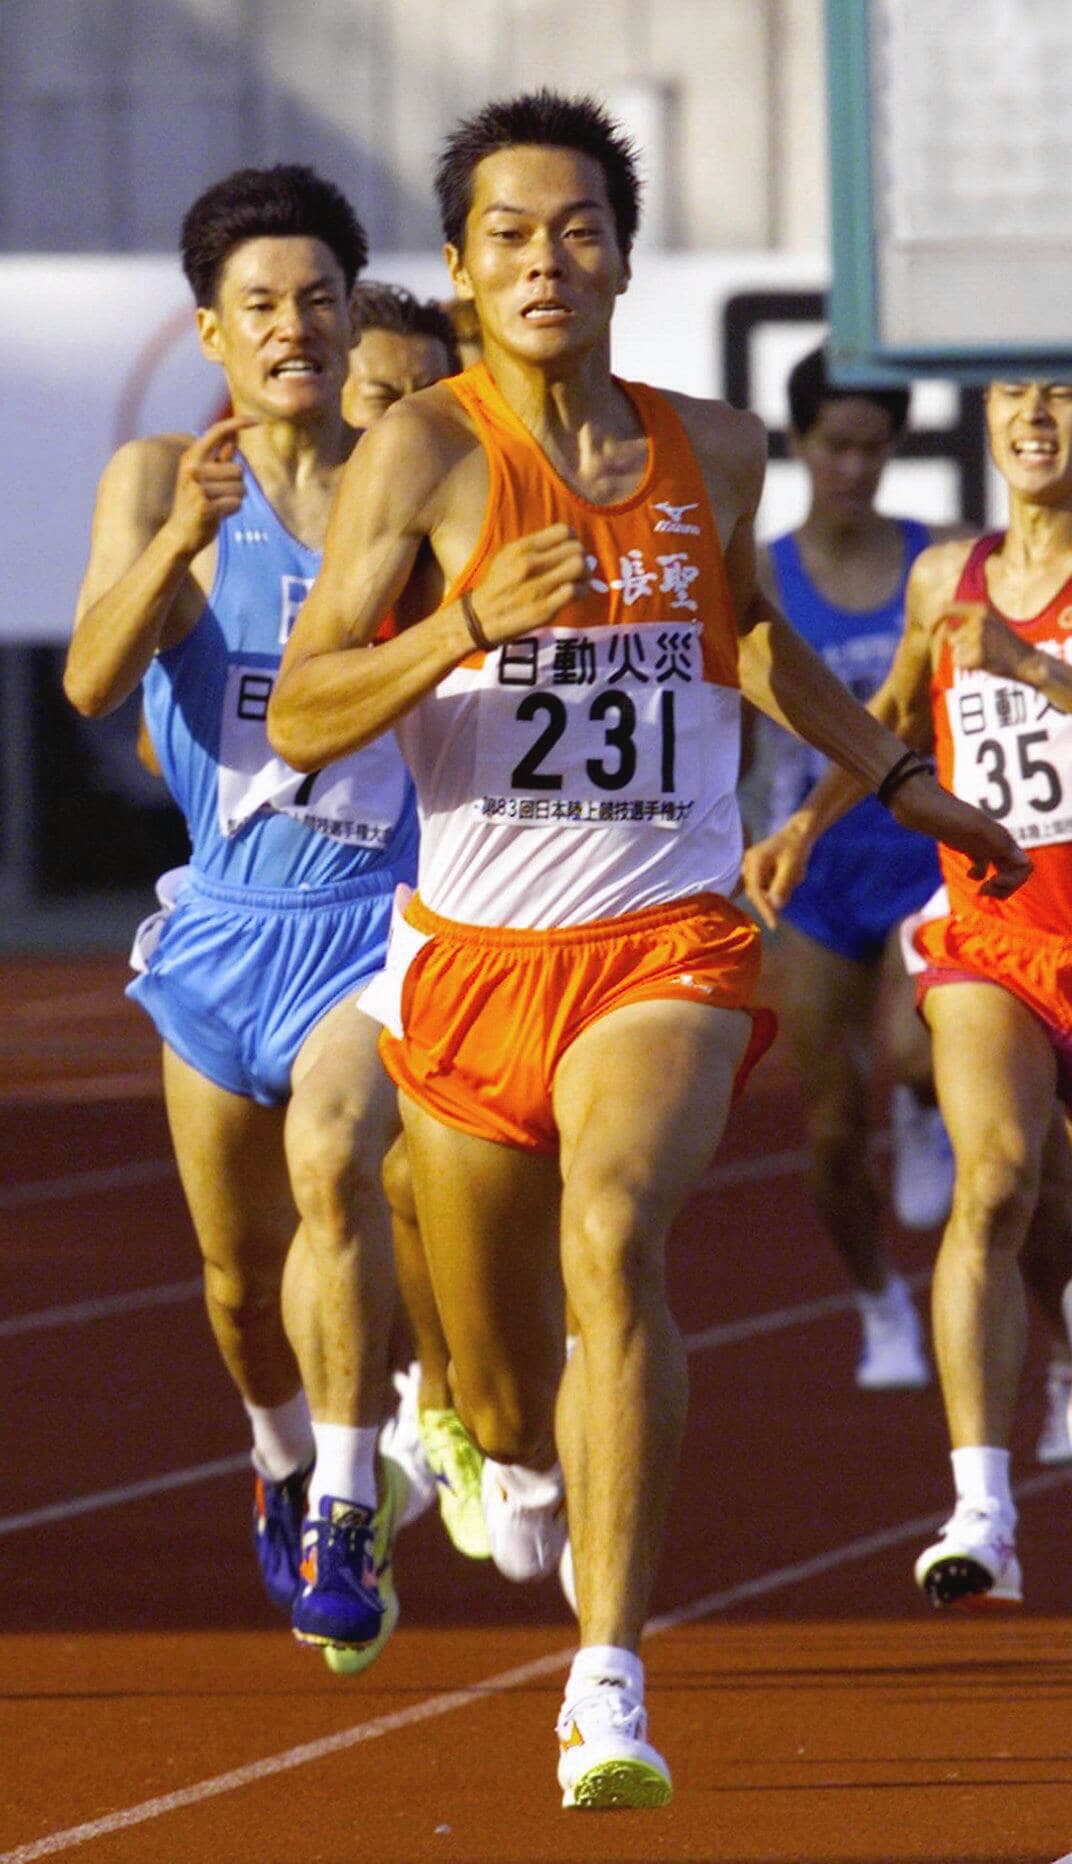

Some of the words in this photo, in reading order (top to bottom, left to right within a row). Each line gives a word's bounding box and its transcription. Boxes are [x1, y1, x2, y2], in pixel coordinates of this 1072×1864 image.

[498, 632, 694, 686] 日動火災
[510, 689, 677, 794] 231
[975, 730, 1063, 820] 35
